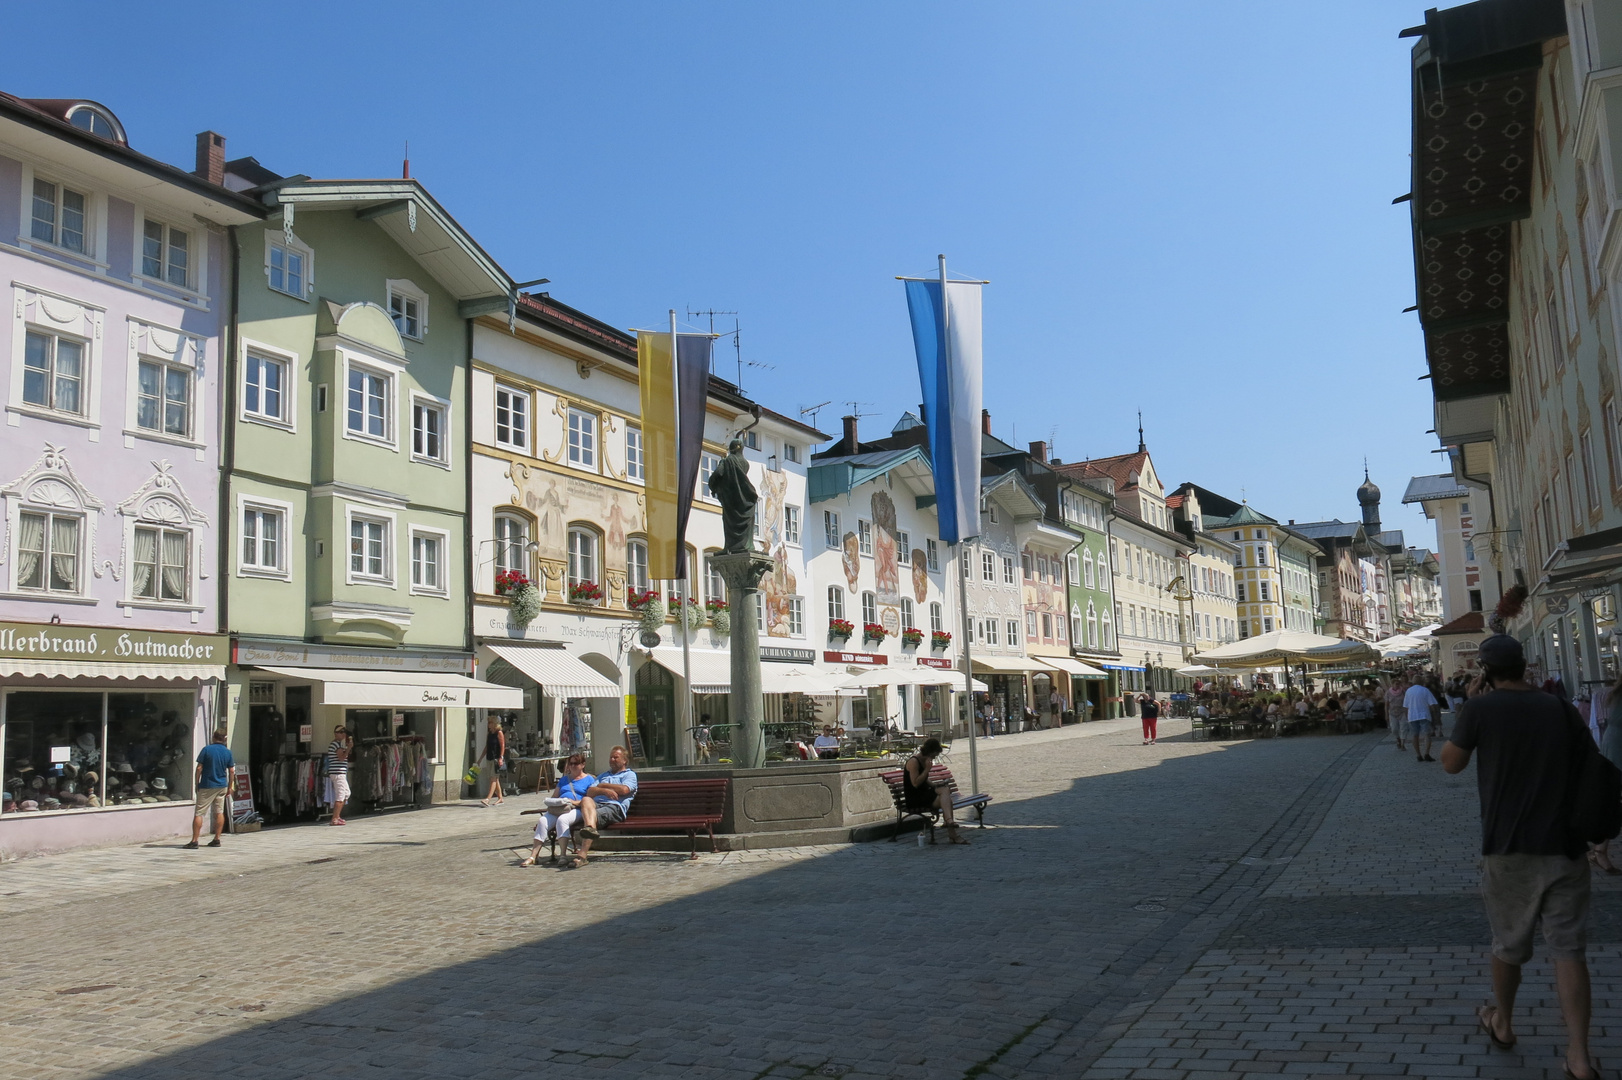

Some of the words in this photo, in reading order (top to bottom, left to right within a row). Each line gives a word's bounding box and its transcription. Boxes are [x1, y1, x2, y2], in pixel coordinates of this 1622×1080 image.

[114, 632, 214, 660] Hutmacher
[244, 645, 271, 661] Sara
[273, 646, 300, 661] Boni
[760, 647, 792, 658] HUHHAUS
[793, 649, 810, 659] MAYR
[381, 655, 404, 666] Mode
[420, 655, 439, 668] Sara
[440, 655, 460, 668] Boni
[421, 690, 439, 702] Sara
[440, 690, 457, 702] Boni
